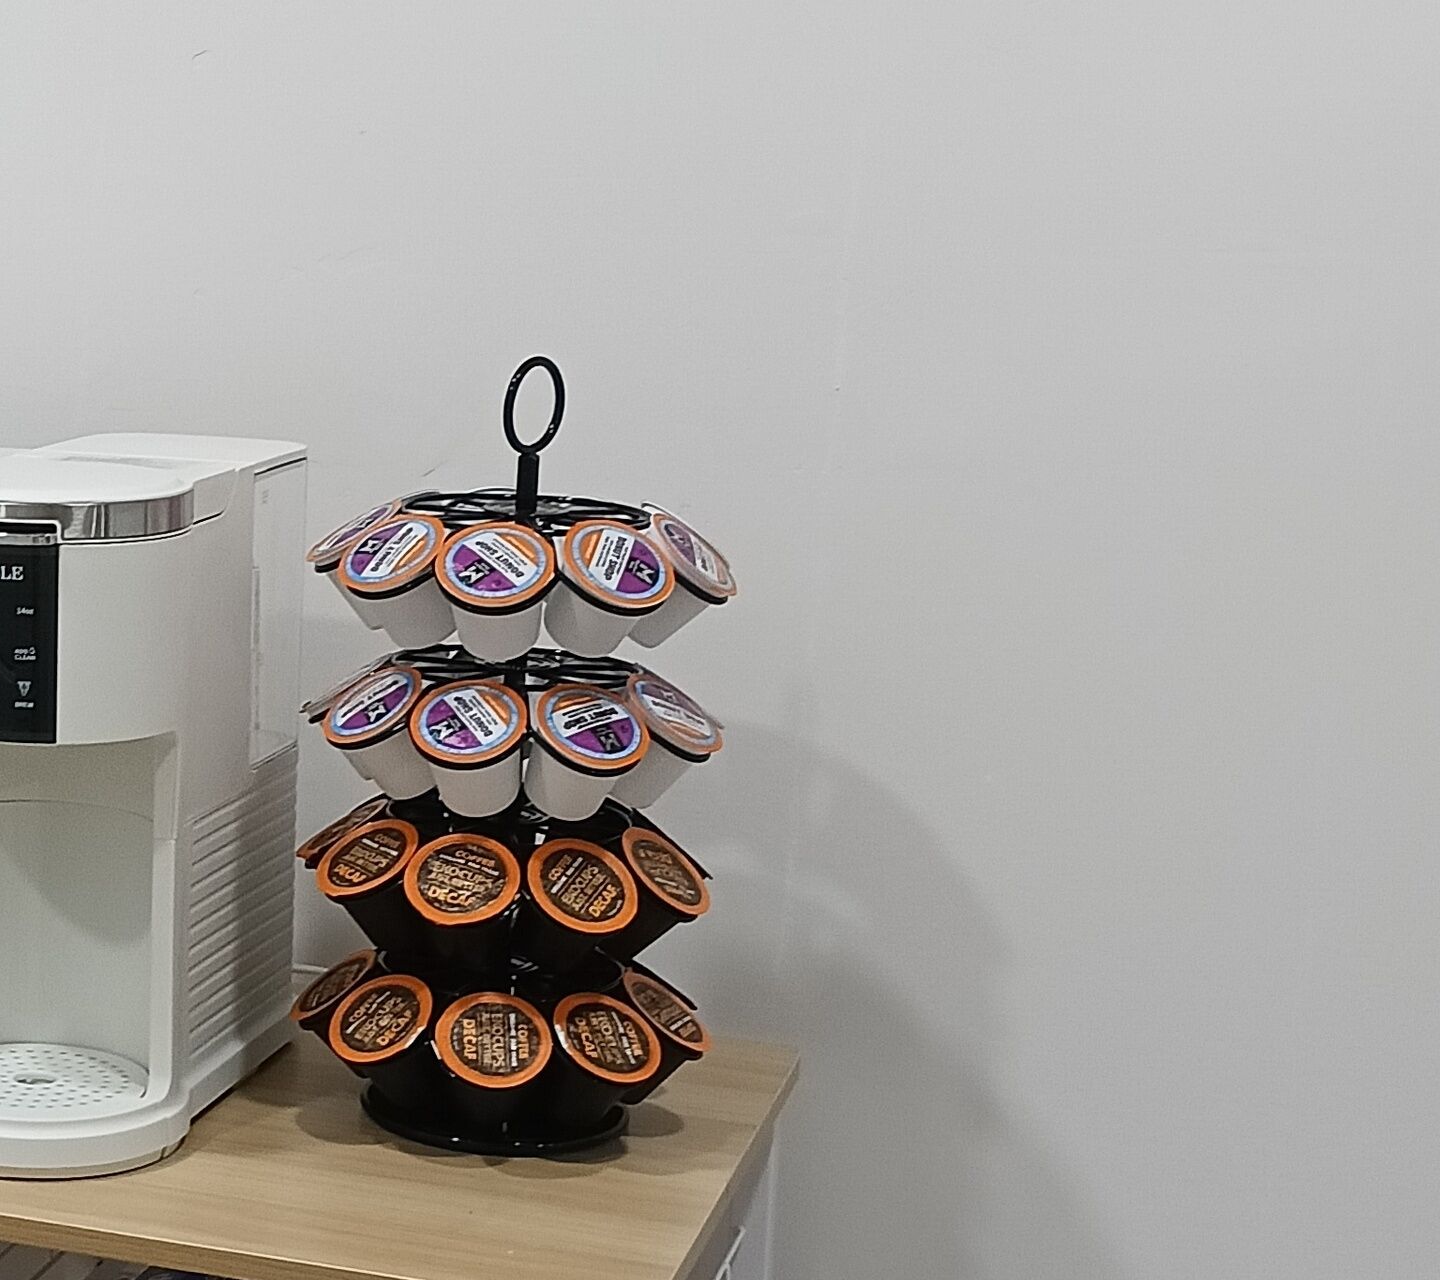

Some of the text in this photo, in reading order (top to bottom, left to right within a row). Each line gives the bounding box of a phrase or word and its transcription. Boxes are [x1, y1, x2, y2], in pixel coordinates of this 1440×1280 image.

[475, 541, 499, 556] SHOP
[496, 554, 525, 578] DONUT
[469, 712, 493, 738] DONUT
[333, 863, 368, 883] DECAF
[427, 885, 476, 907] DECAF
[588, 884, 618, 918] DECAF
[376, 1009, 413, 1047] DECAF
[462, 1018, 478, 1060] DECAF
[574, 1016, 599, 1058] DECAF
